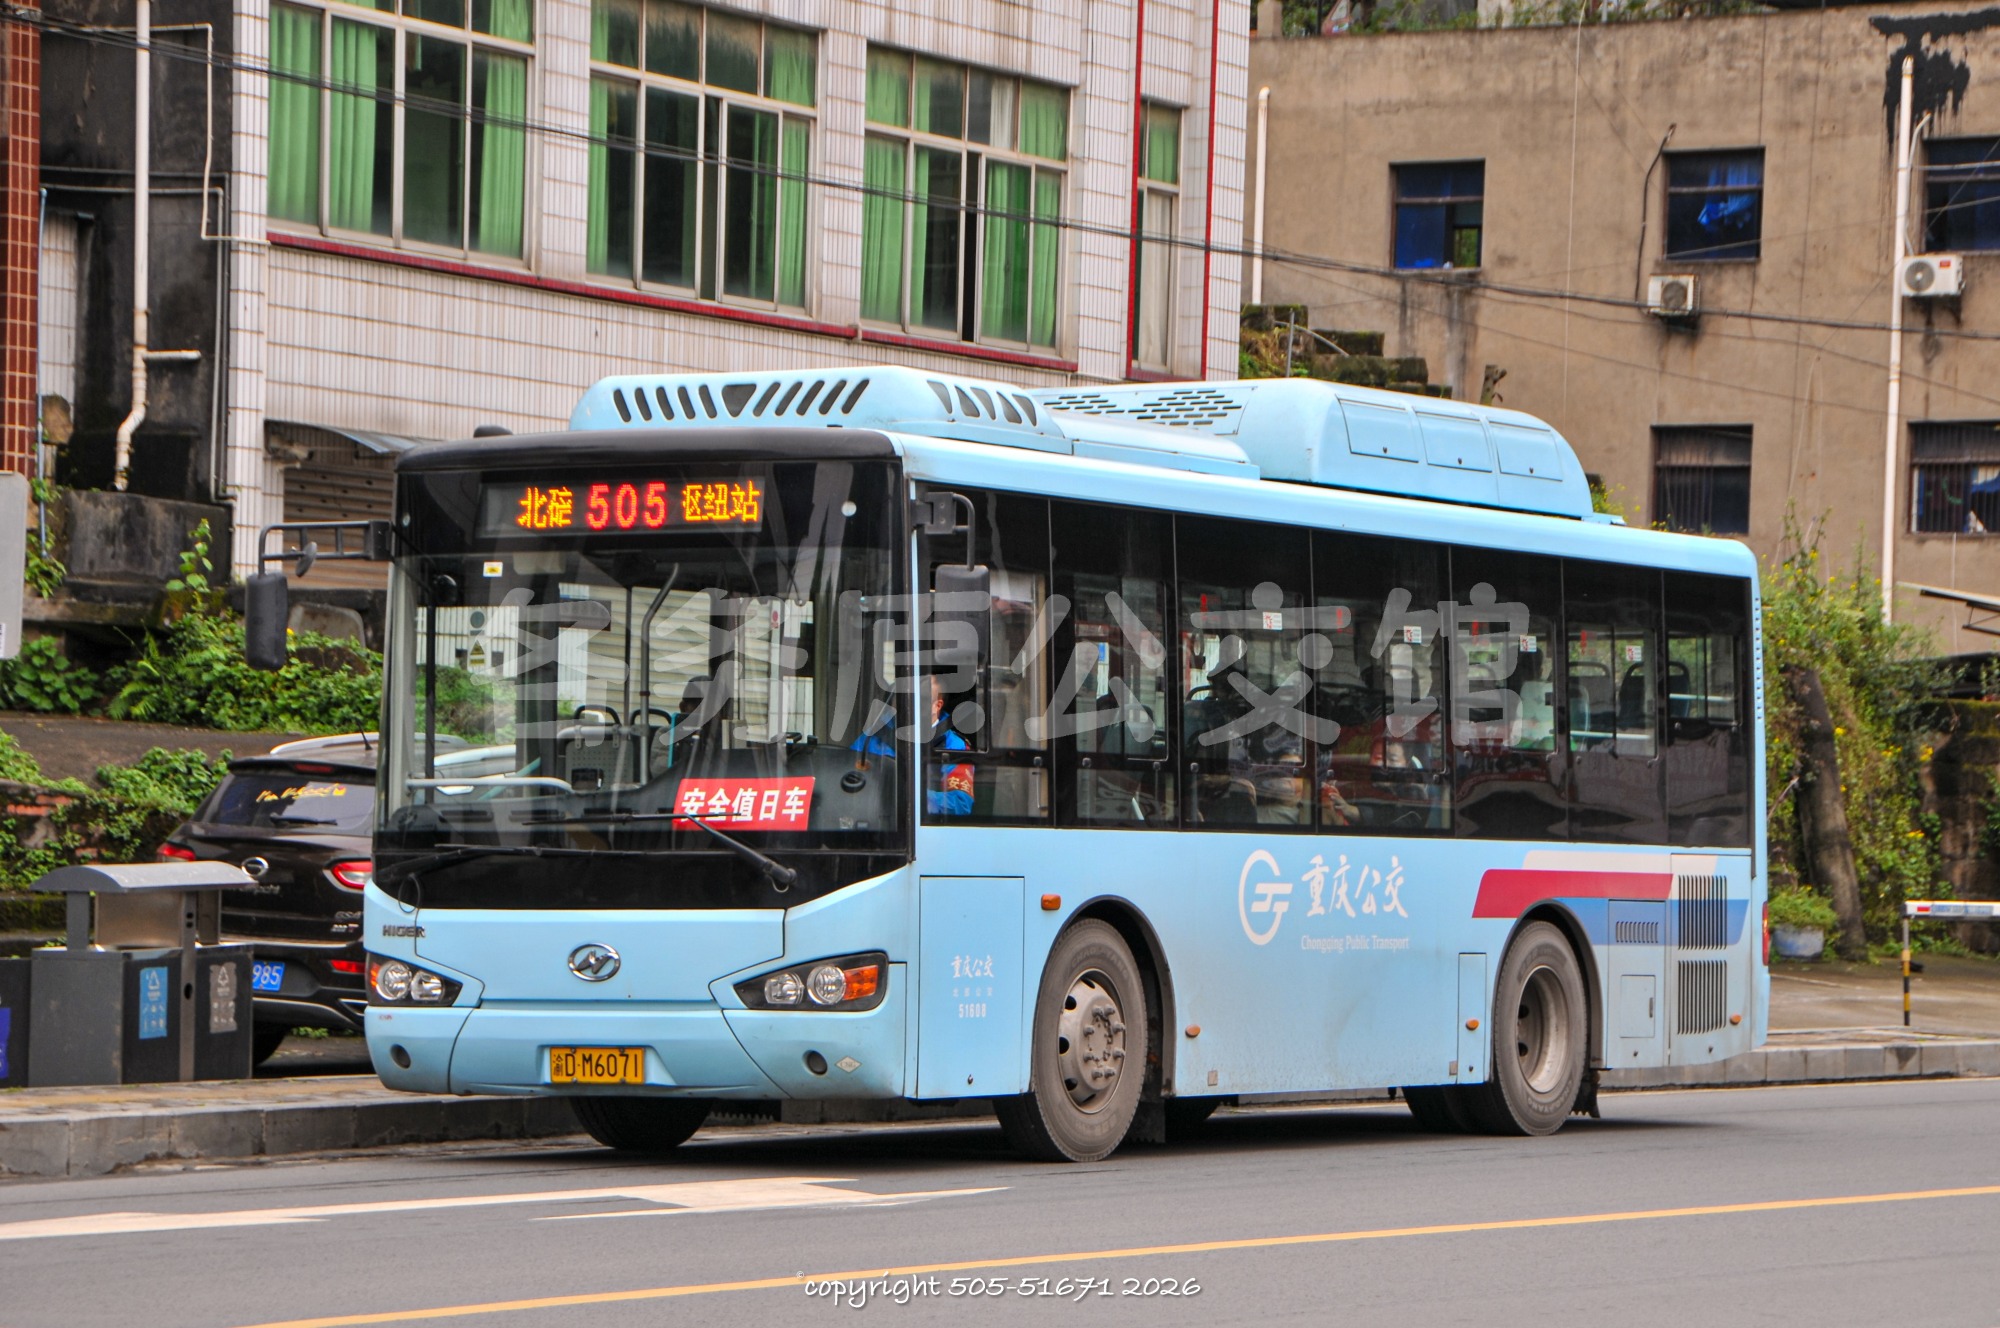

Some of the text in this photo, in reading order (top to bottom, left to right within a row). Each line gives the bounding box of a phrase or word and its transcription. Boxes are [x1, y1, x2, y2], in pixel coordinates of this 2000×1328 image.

[586, 482, 667, 529] 505
[680, 786, 807, 822] 安全值日车
[1301, 854, 1408, 919] 重庆公交
[382, 925, 425, 937] HIGER
[1301, 935, 1410, 953] Chongqing Public Transport
[951, 955, 994, 978] 重庆公交
